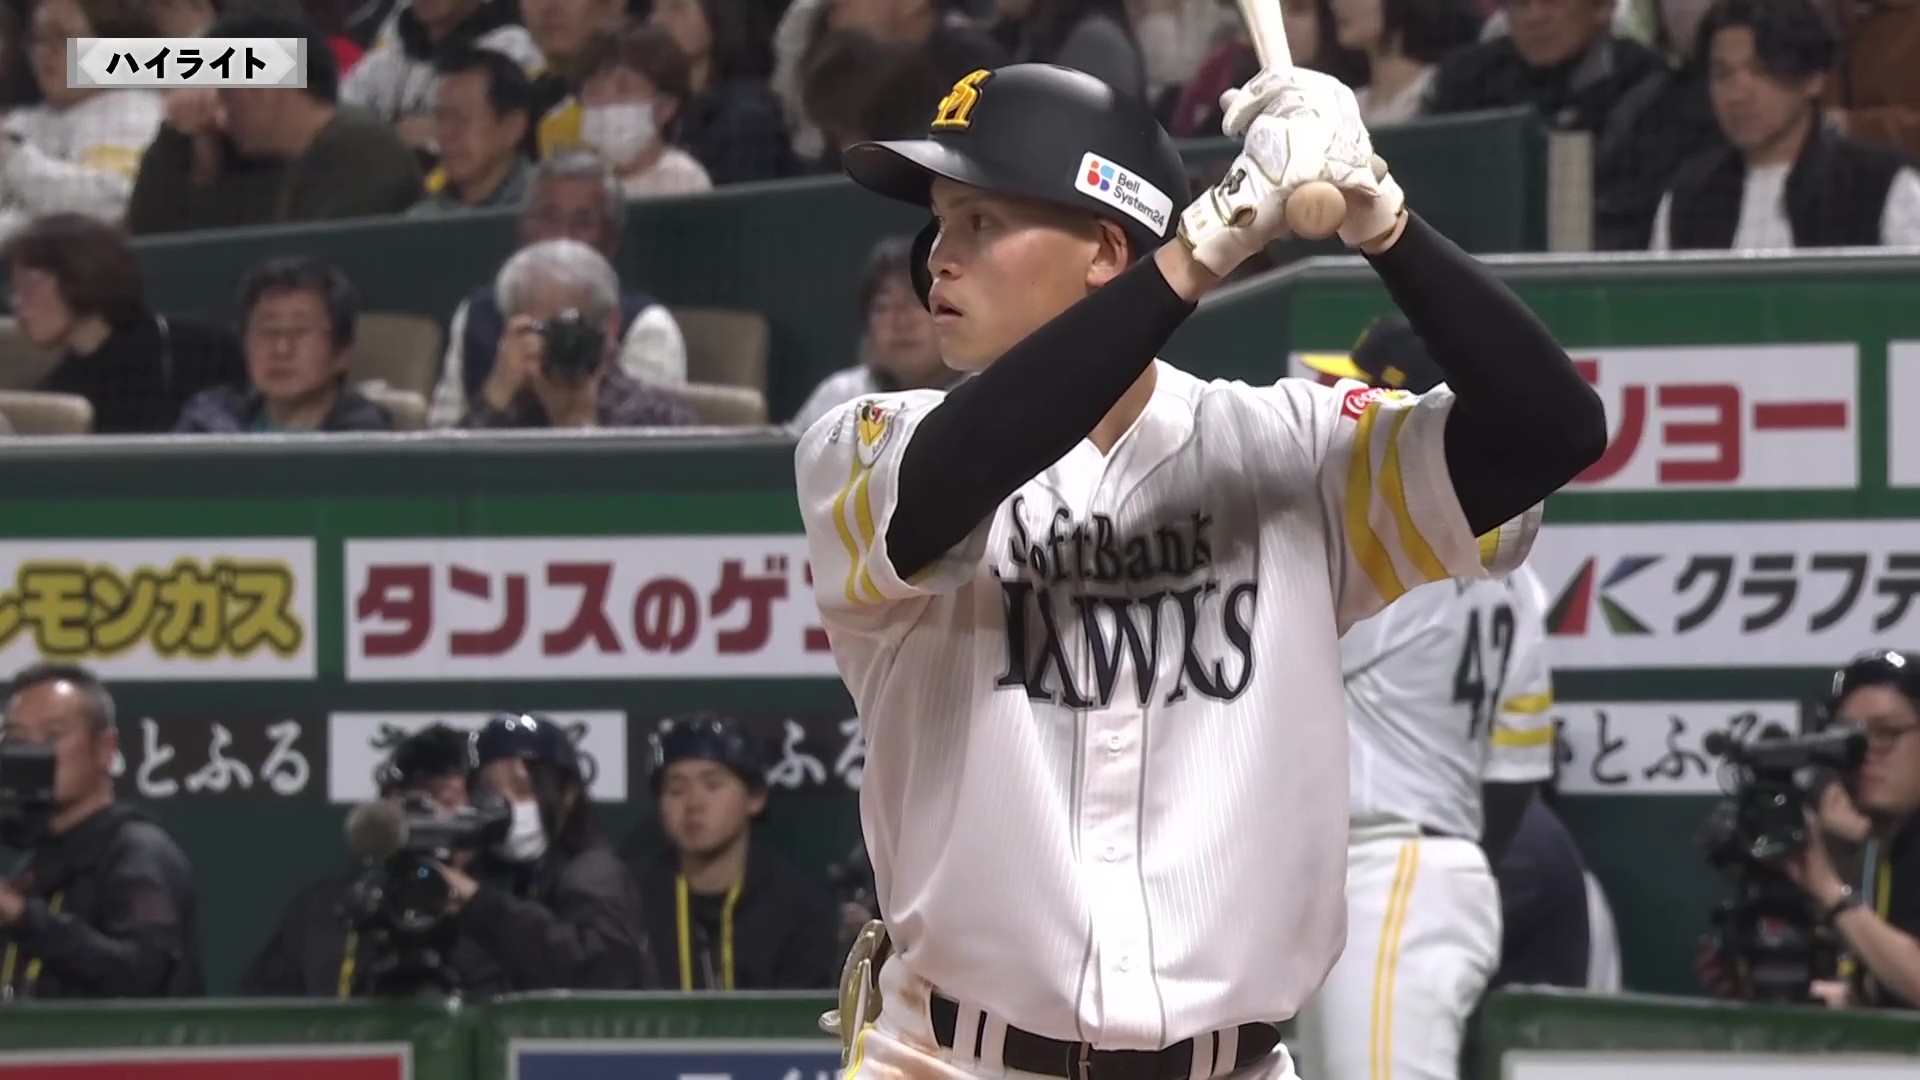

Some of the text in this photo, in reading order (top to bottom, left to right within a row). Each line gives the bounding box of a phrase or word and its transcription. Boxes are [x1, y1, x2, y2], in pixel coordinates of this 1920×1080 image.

[1113, 187, 1165, 228] System24
[1117, 173, 1141, 194] Bell
[1010, 495, 1214, 582] SoftBank
[355, 554, 833, 658] タンスのゲ
[1453, 603, 1515, 740] 42
[108, 716, 310, 797] とふる
